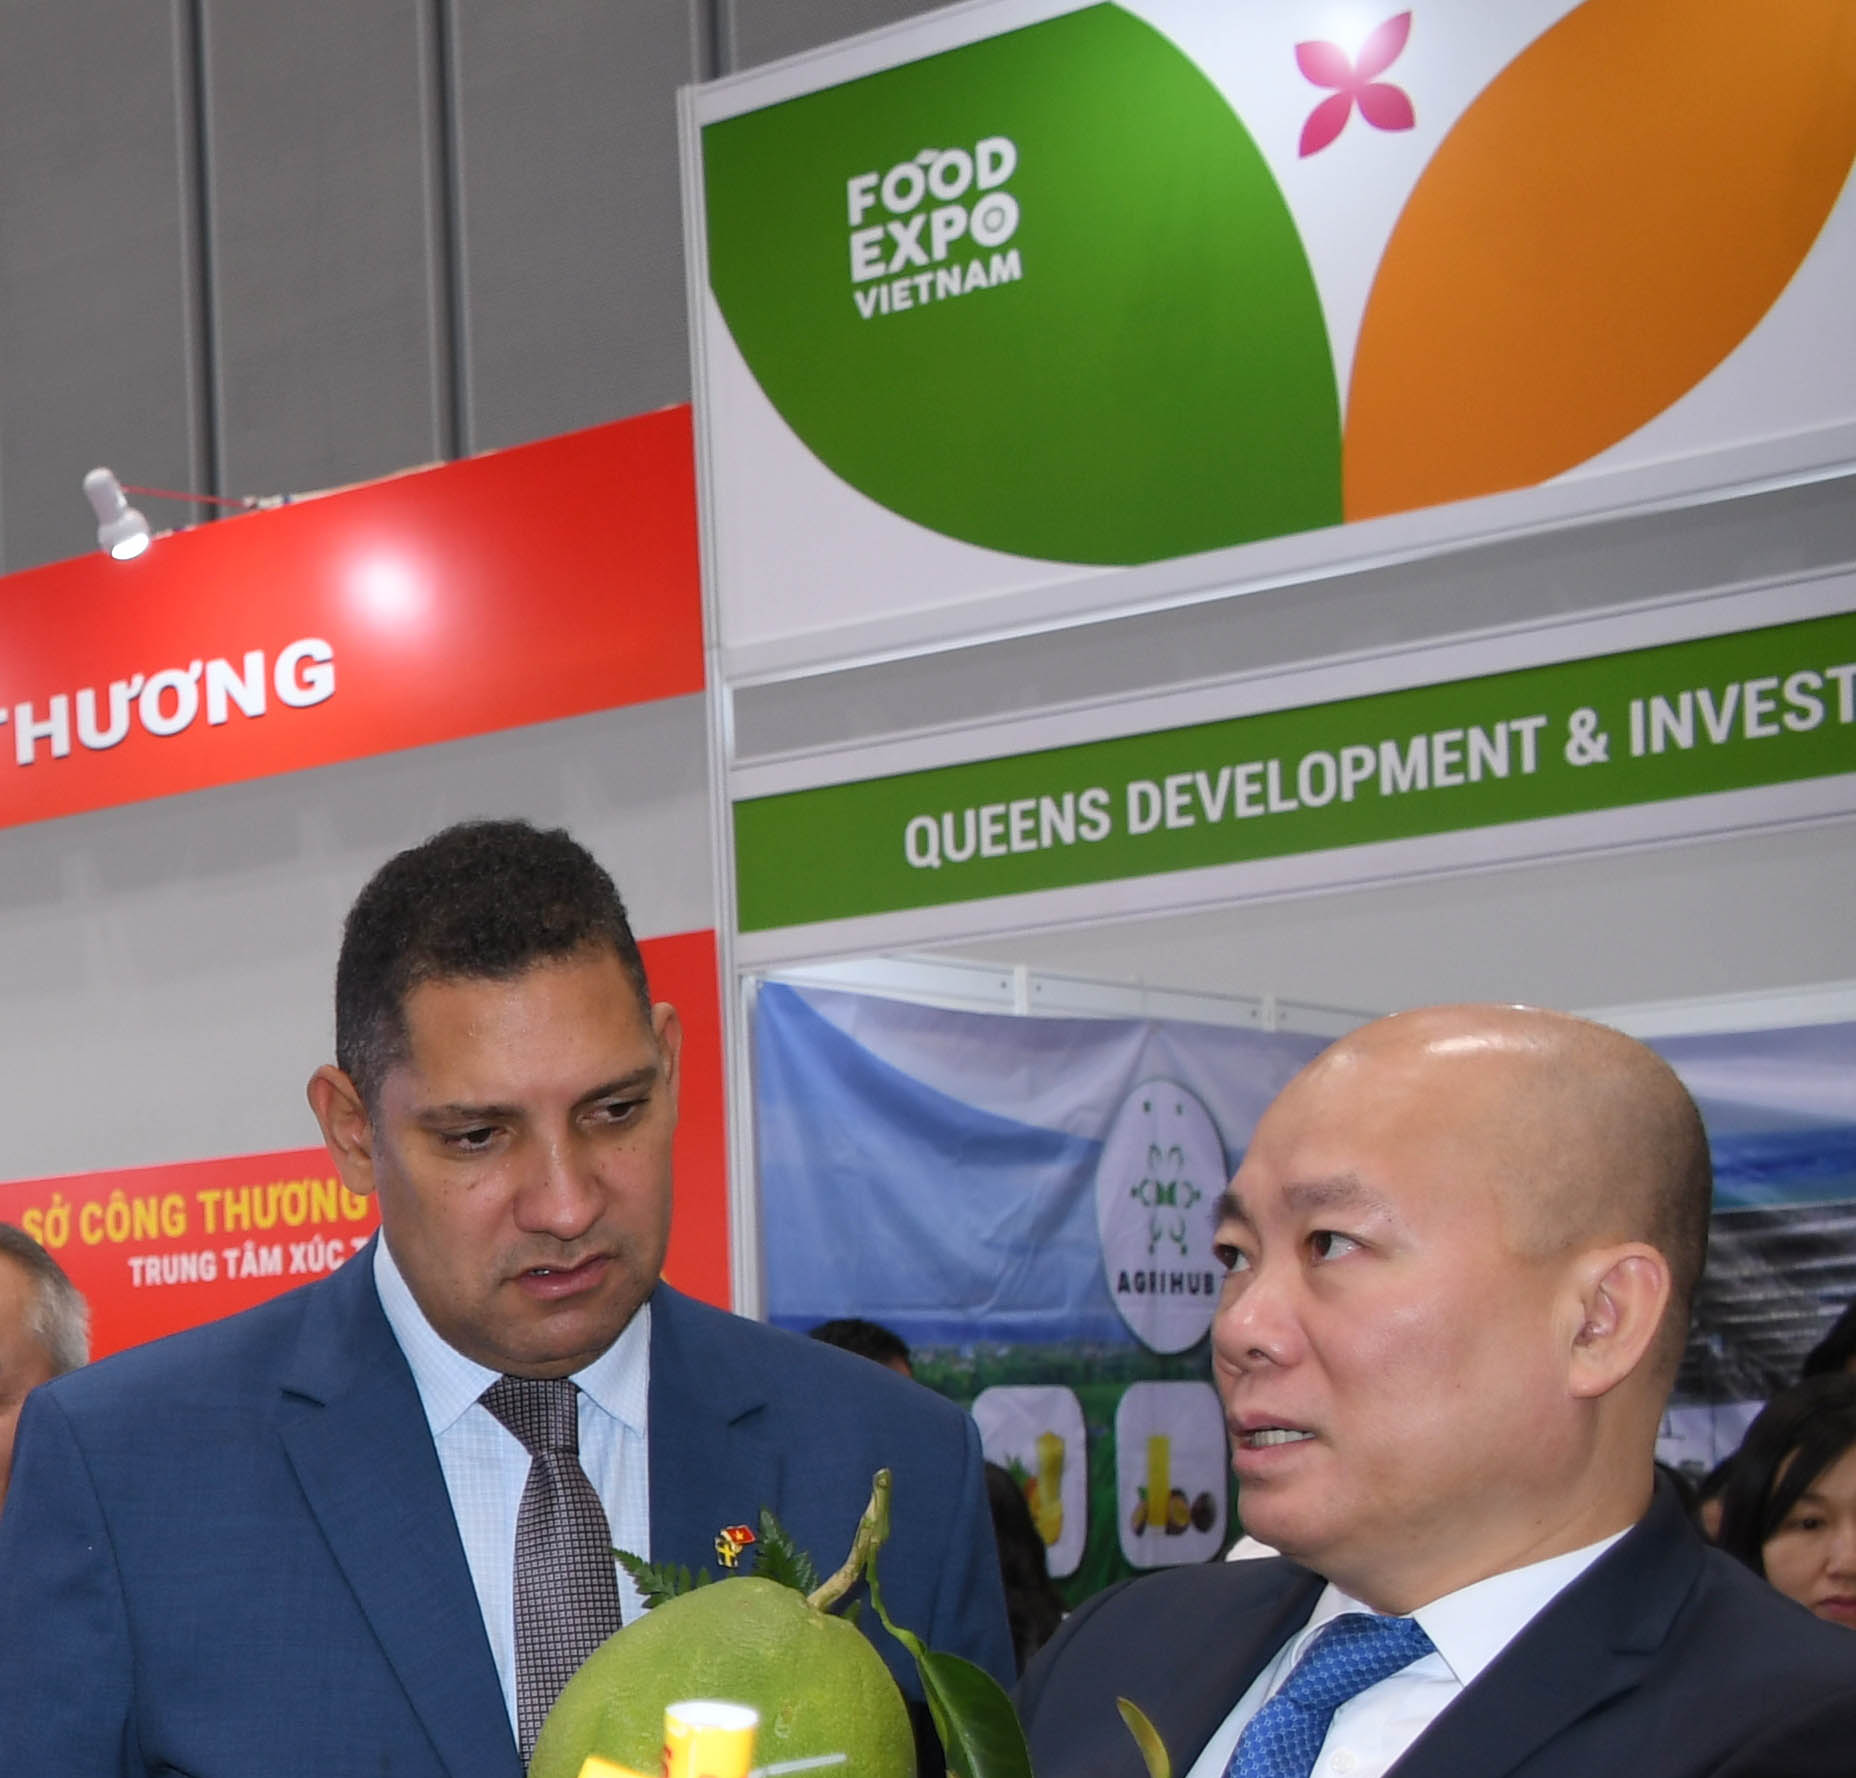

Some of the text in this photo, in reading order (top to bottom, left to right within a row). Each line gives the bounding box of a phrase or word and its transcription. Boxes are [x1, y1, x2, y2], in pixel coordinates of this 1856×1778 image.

[847, 136, 1017, 228] FOOD
[850, 191, 1020, 284] EXPO
[854, 248, 1023, 321] VIETNAM
[904, 786, 1112, 869] QUEENS
[1126, 715, 1548, 835] DEVELOPMENT
[1563, 707, 1610, 767] &
[21, 1177, 369, 1249] SỞ CÔNG THƯƠNG
[128, 1232, 345, 1288] TRUNG TÂM XÚC
[1117, 1268, 1215, 1296] AGRIHUB
